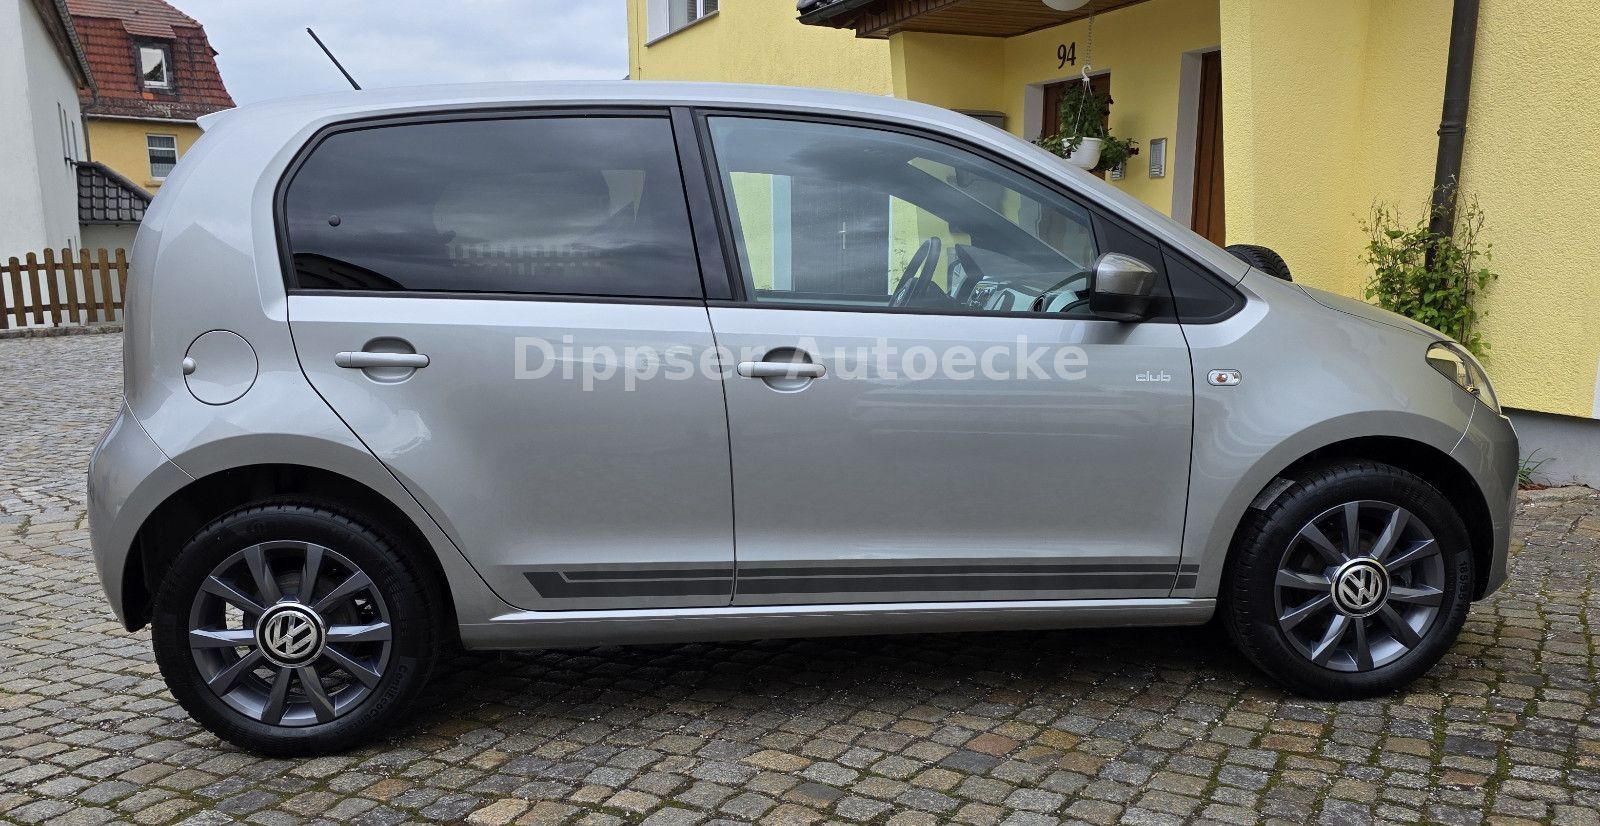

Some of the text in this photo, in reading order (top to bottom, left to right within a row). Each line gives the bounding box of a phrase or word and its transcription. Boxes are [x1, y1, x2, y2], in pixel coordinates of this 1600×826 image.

[1057, 41, 1077, 70] 94
[1135, 370, 1172, 382] club
[1339, 565, 1382, 609] VW
[265, 610, 318, 658] VW
